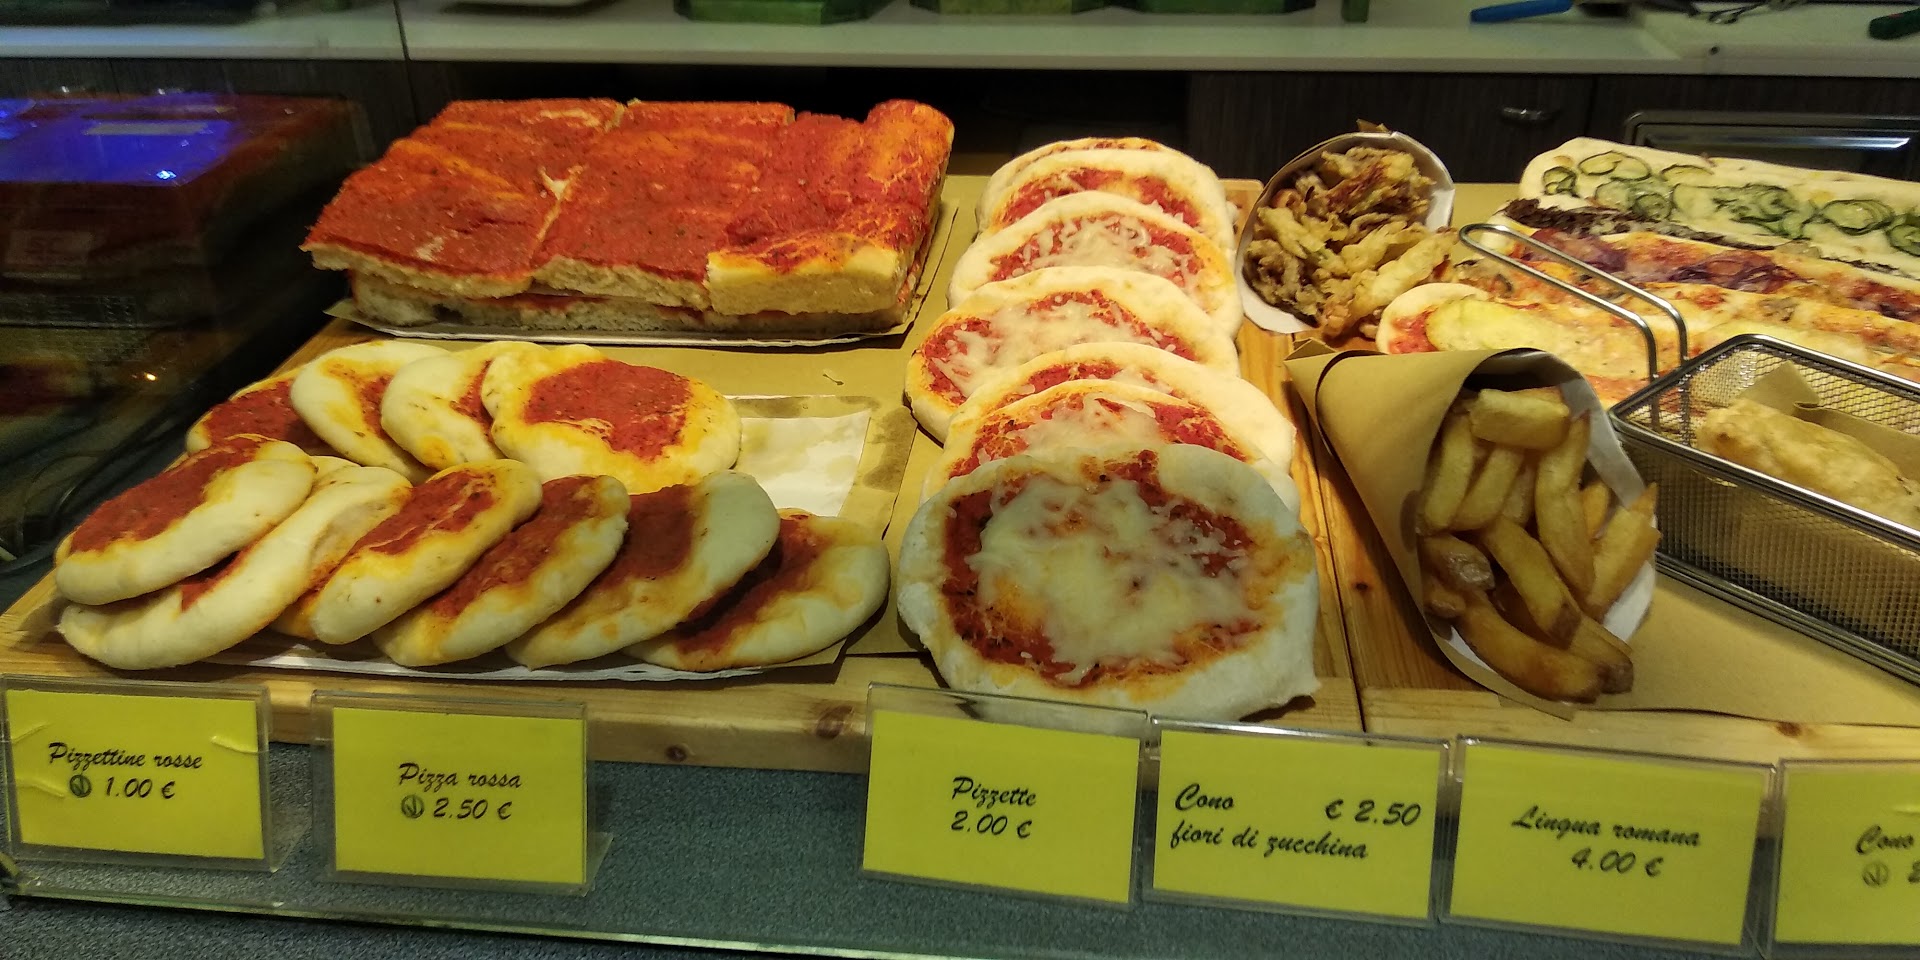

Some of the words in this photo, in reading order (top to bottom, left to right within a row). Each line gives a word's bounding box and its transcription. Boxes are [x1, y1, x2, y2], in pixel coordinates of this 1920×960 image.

[48, 741, 148, 774] Pizzettine
[154, 753, 205, 770] rosse
[105, 776, 154, 800] 1.00
[160, 780, 177, 800] €
[398, 762, 460, 789] Pizza
[468, 771, 524, 790] rossa
[951, 775, 1039, 809] Pizzette
[432, 797, 490, 821] 2.50
[496, 801, 515, 822] €
[1174, 783, 1237, 812] Cono
[1324, 798, 1345, 822] €
[1354, 799, 1423, 828] 2.50
[950, 805, 1009, 837] 2.00
[1016, 819, 1034, 840] €
[1510, 804, 1602, 842] Lingua
[1612, 824, 1704, 849] romana
[1170, 819, 1225, 850] fiori
[1231, 826, 1260, 849] di
[1263, 834, 1369, 861] zucchina
[1855, 824, 1916, 856] Cono
[1571, 847, 1639, 876] 4.00
[1644, 856, 1666, 879] €
